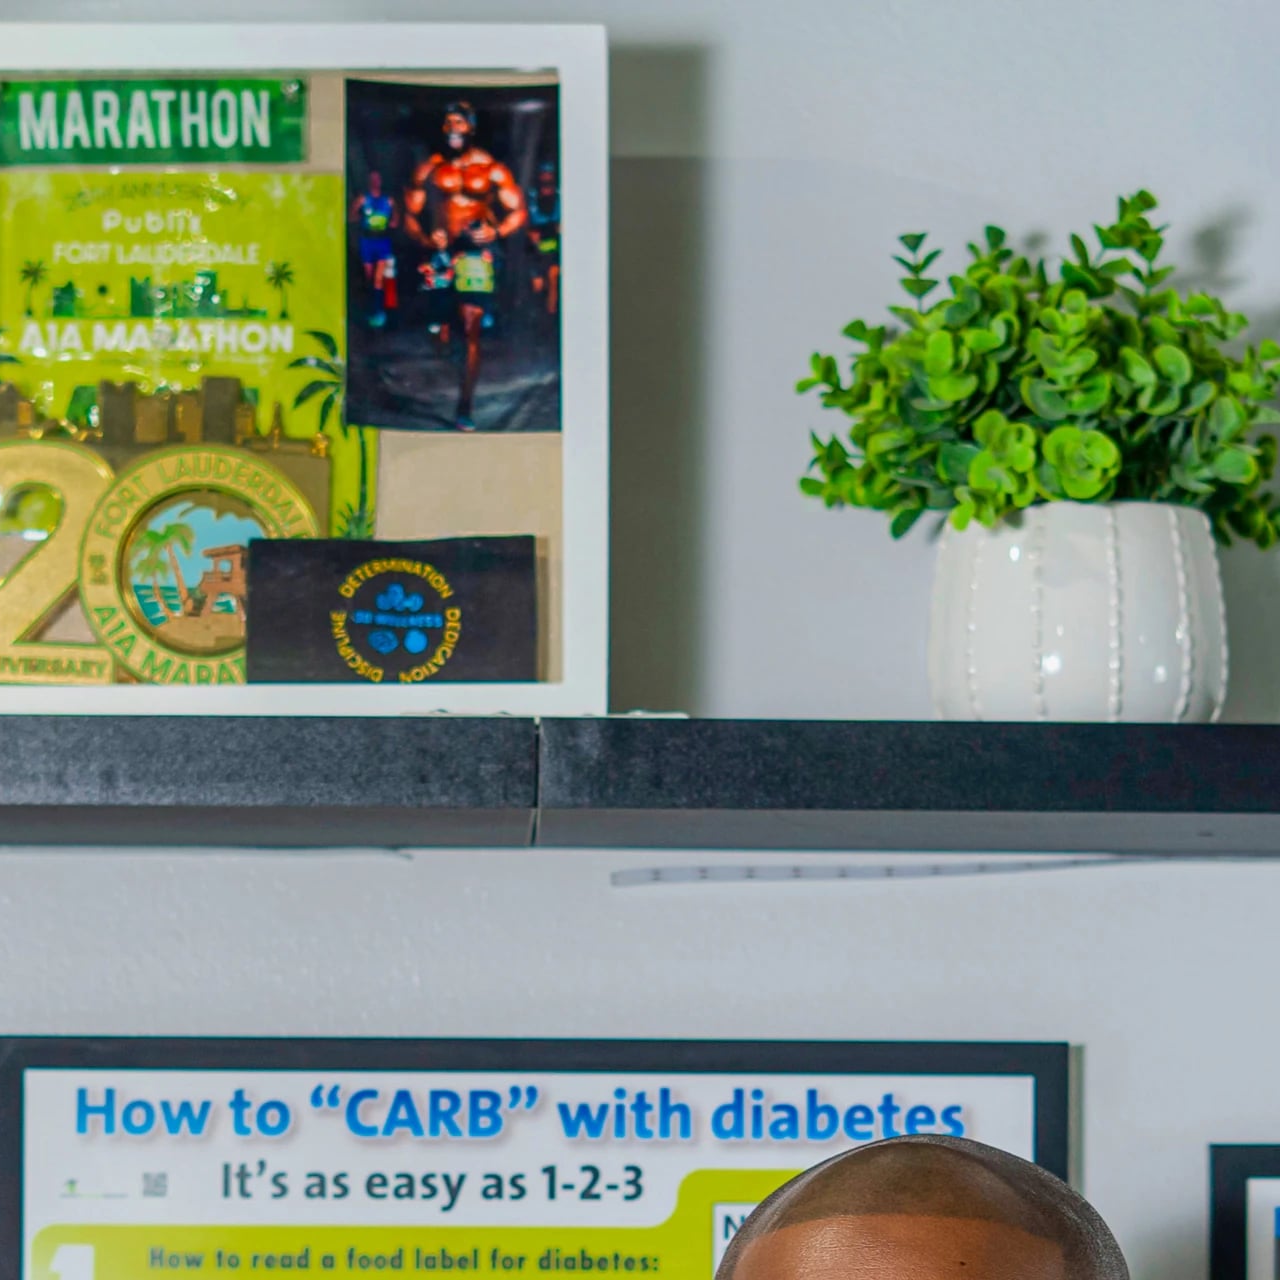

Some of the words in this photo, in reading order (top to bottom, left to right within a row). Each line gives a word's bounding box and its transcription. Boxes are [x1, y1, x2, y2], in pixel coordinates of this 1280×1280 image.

[20, 89, 270, 149] MARATHON
[102, 209, 202, 234] Publix
[53, 243, 112, 264] FORT
[117, 244, 260, 265] LAUDERDALE
[92, 322, 293, 352] MARATHON
[95, 473, 153, 538] FORT
[160, 456, 311, 538] LAUDERDAL
[339, 558, 454, 598] DETERMINATION
[93, 606, 136, 657] A1A
[330, 611, 383, 682] DISCIPLINE
[399, 607, 461, 683] DEDICATION
[76, 1087, 210, 1135] How
[230, 1089, 291, 1136] to
[558, 1088, 692, 1139] with
[711, 1088, 965, 1141] diabetes
[304, 1171, 349, 1199] as
[364, 1171, 468, 1210] easy
[481, 1172, 528, 1199] as
[539, 1166, 644, 1200] 1-2-3
[149, 1247, 204, 1269] How
[216, 1249, 241, 1269] to
[252, 1247, 310, 1269] read
[321, 1253, 336, 1269] a
[347, 1247, 404, 1270] food
[415, 1247, 478, 1270] label
[490, 1247, 526, 1270] for
[538, 1248, 659, 1272] diabetes:
